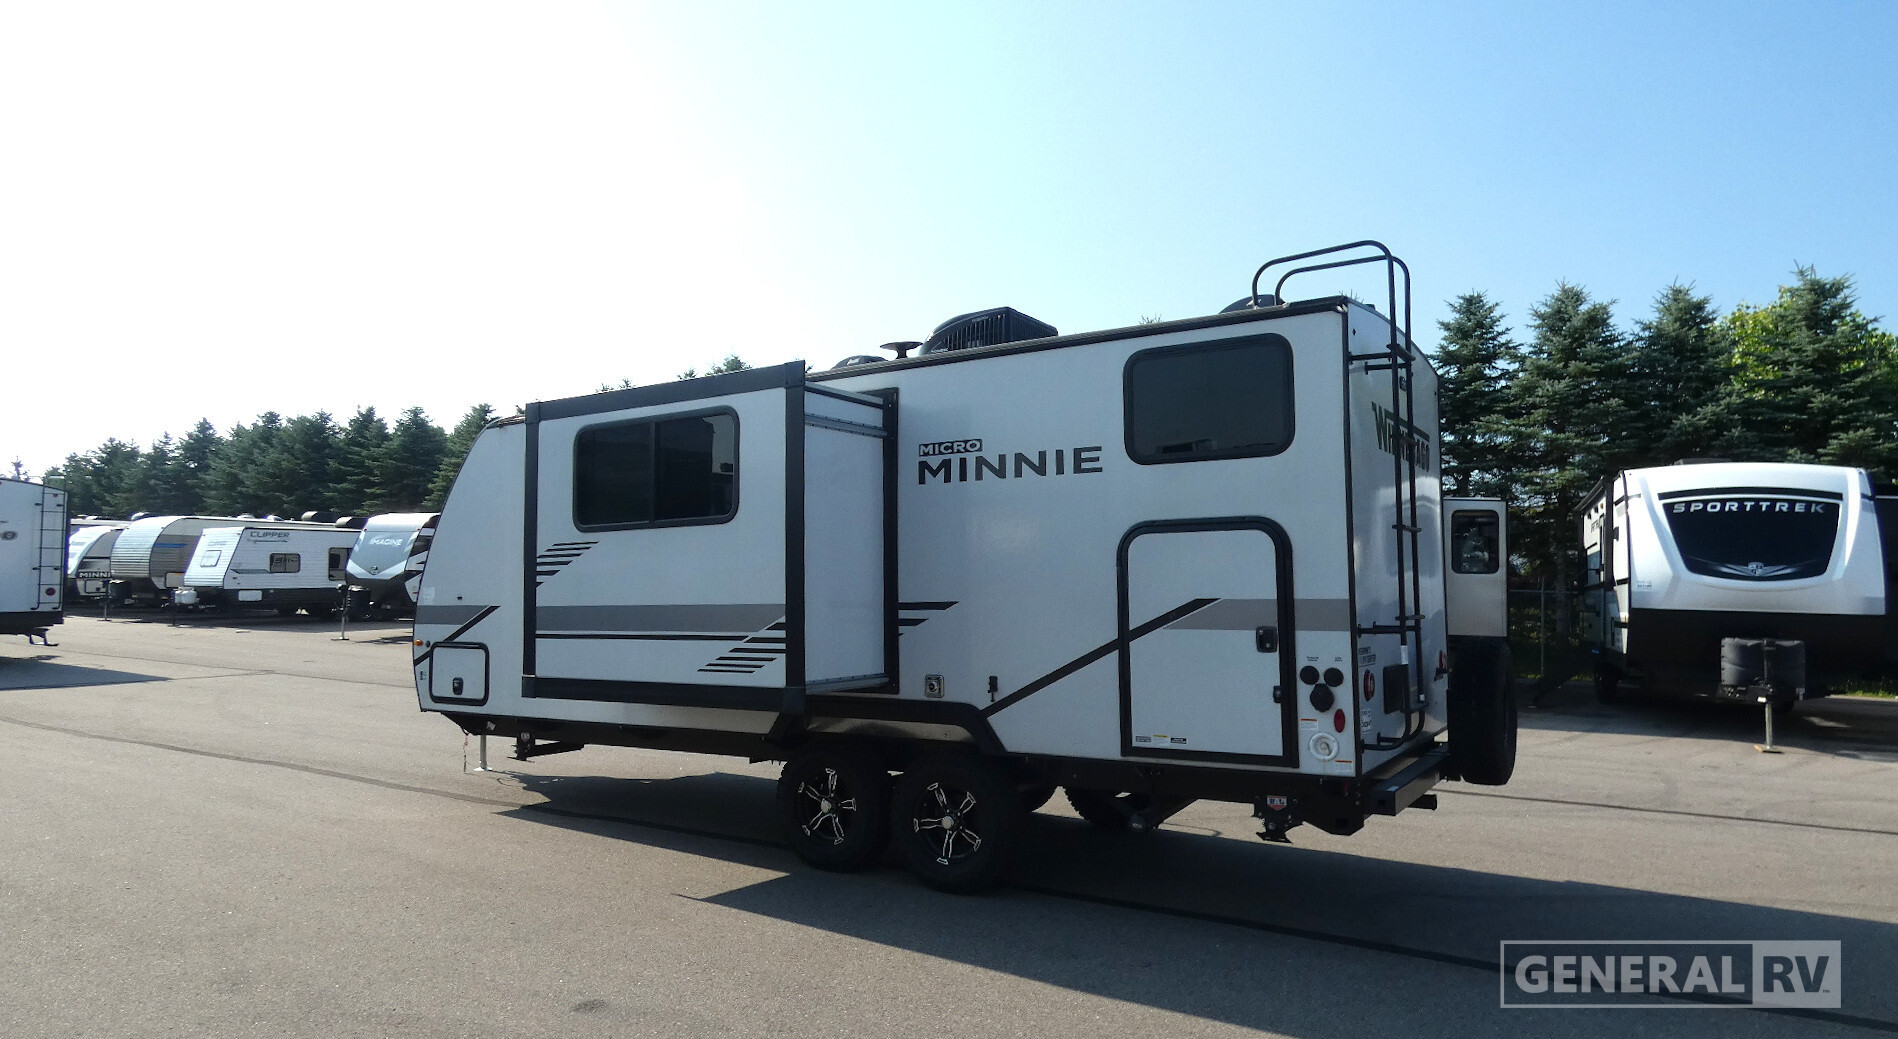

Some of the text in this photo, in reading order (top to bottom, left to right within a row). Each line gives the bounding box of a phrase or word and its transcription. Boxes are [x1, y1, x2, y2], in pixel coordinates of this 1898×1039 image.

[919, 440, 981, 456] MICRO
[918, 446, 1103, 485] MINNIE
[1672, 501, 1825, 514] SPORTTREK
